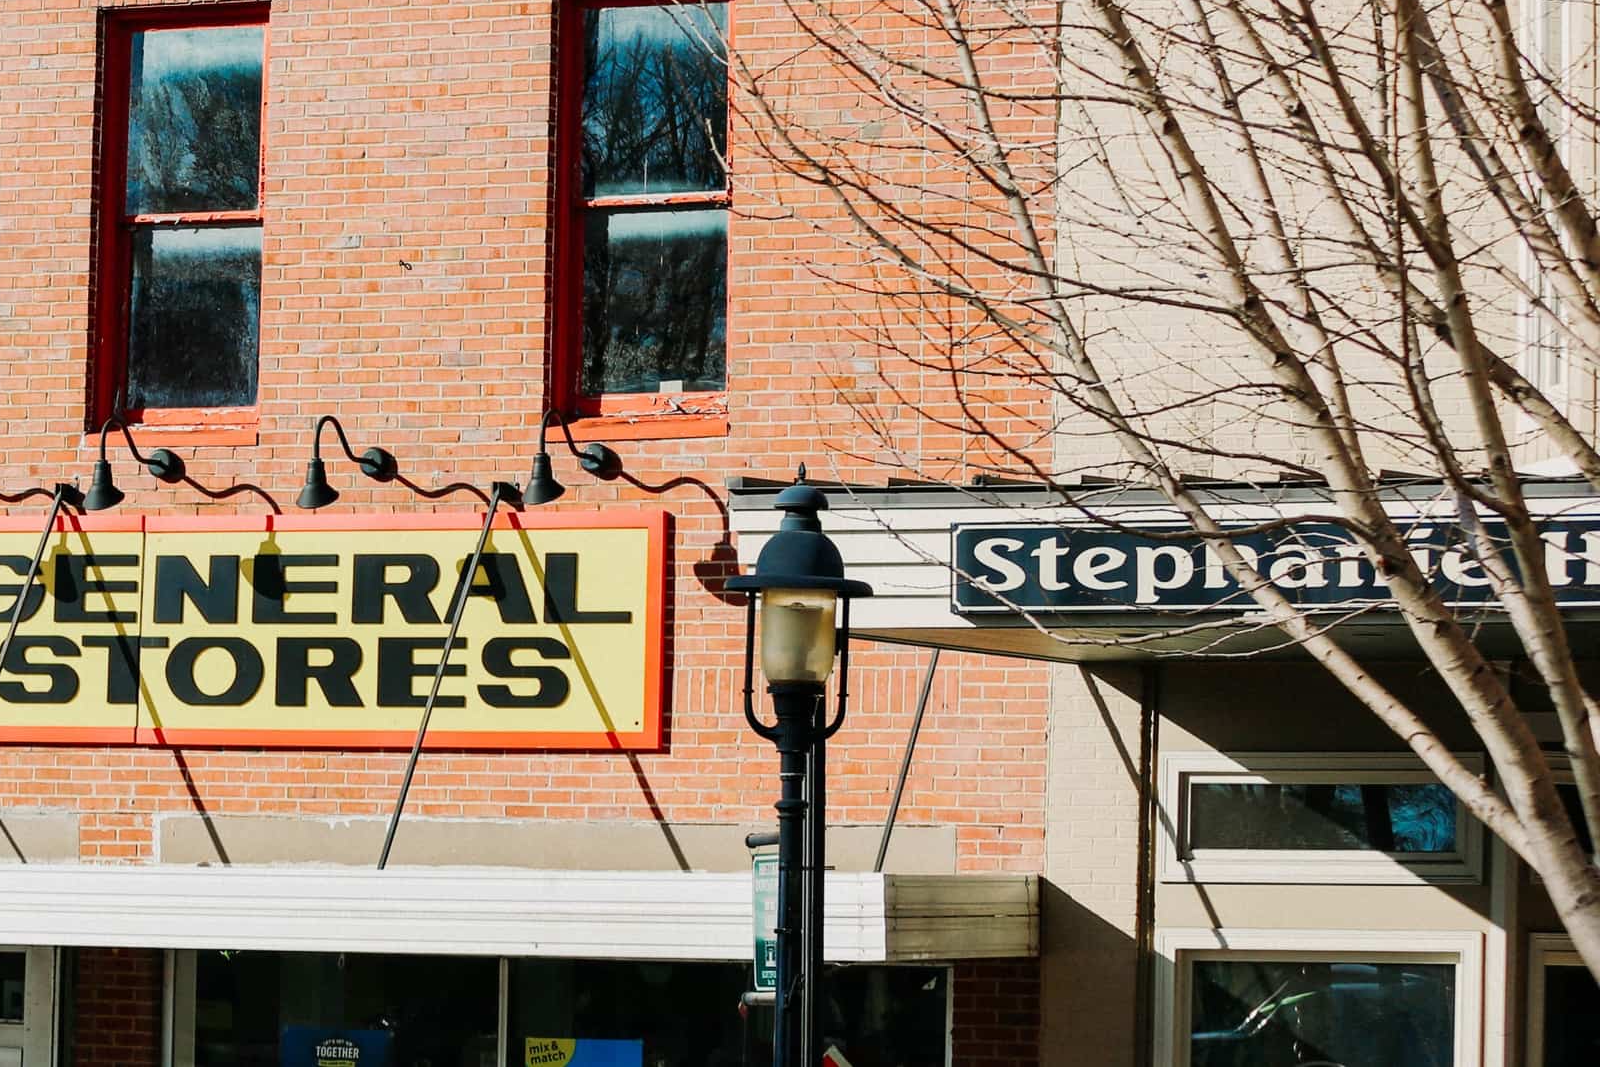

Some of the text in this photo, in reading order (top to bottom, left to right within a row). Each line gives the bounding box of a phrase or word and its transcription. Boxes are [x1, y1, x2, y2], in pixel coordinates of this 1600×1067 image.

[315, 1046, 360, 1059] TOGETHER
[529, 1042, 550, 1054] mix
[530, 1050, 566, 1065] match
